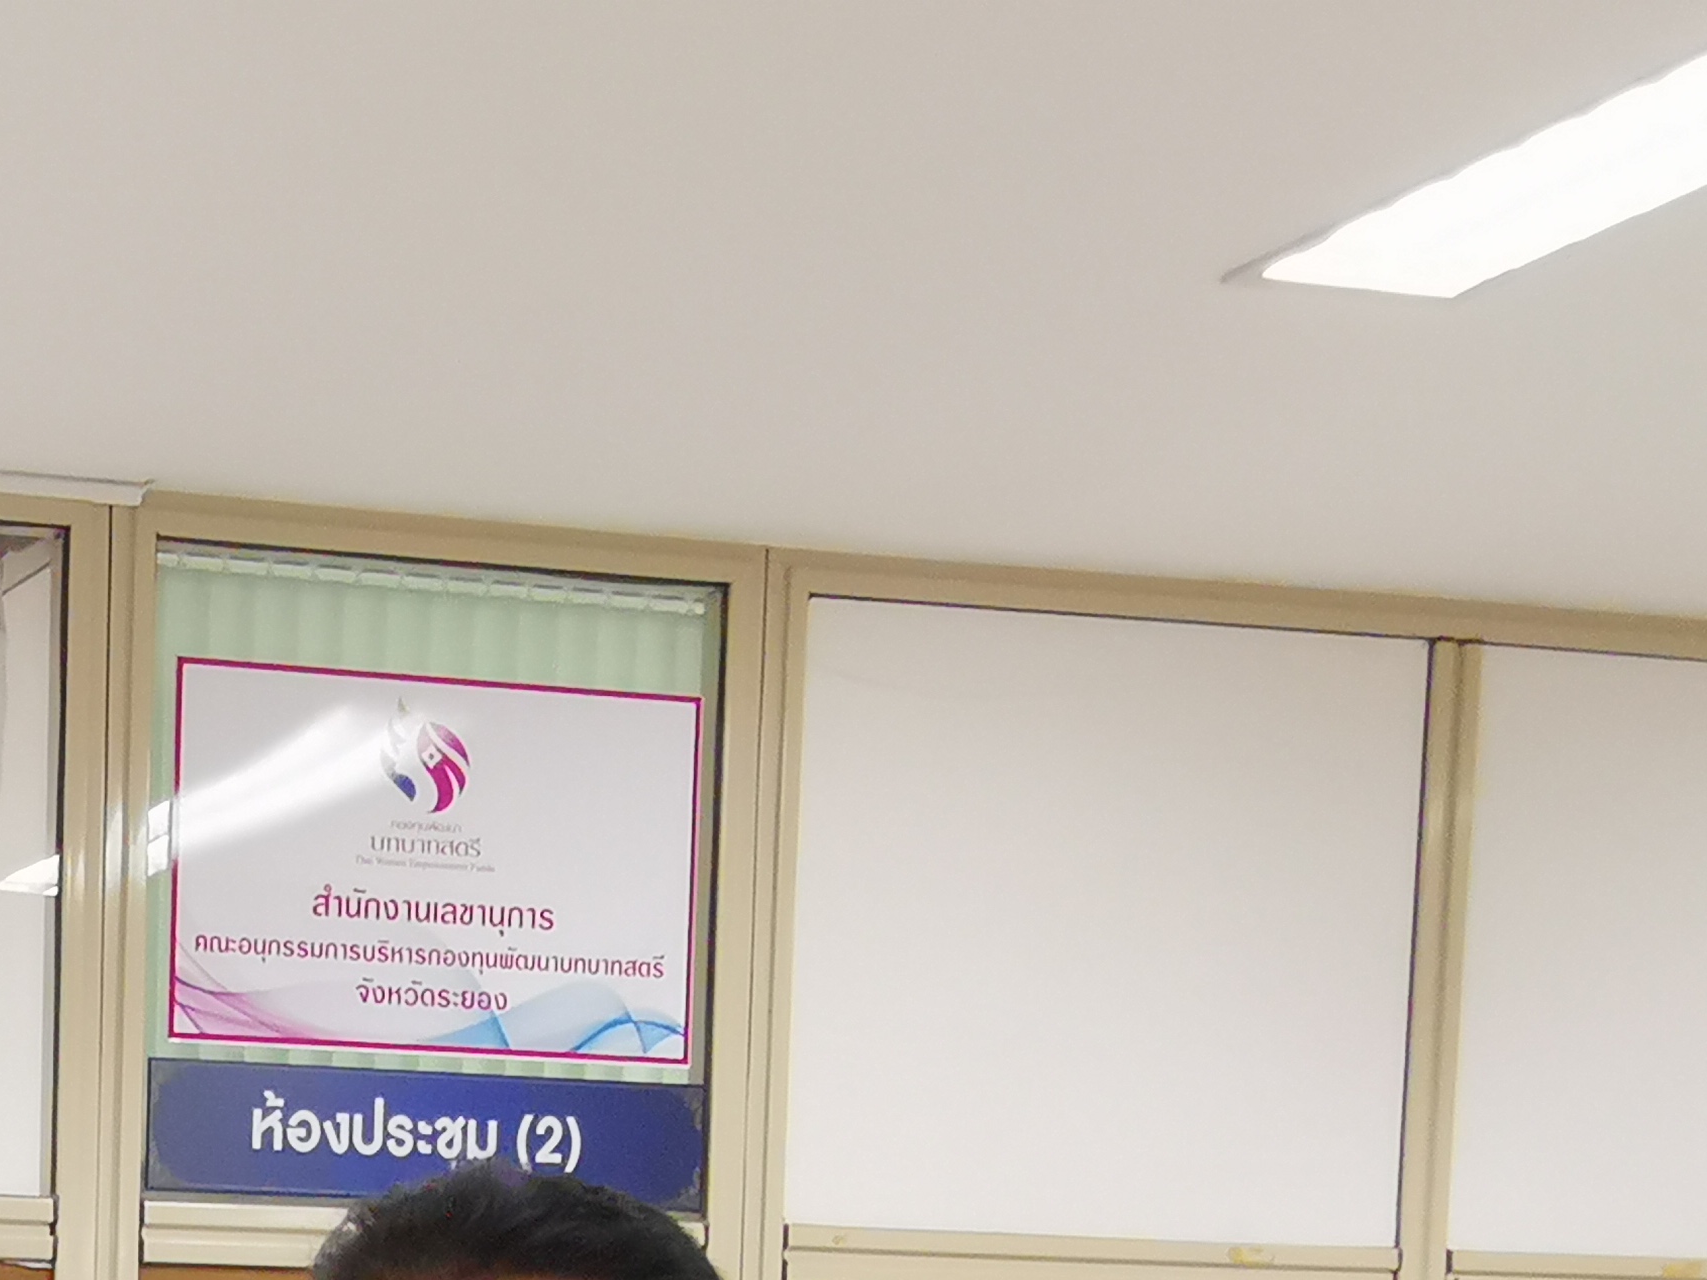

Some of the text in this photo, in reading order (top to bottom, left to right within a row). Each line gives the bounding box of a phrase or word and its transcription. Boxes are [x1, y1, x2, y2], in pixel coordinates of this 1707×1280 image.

[370, 836, 482, 858] บทบาทสตรี
[312, 883, 554, 936] สำนักงานเลขานุการ
[194, 934, 665, 979] คณะอนุกรรมการบริหารกองทุนพัฒนาบทบาทสตรี
[355, 977, 508, 1010] จังหวัดระยอง
[251, 1089, 582, 1173] ห้องประชุม (2)
